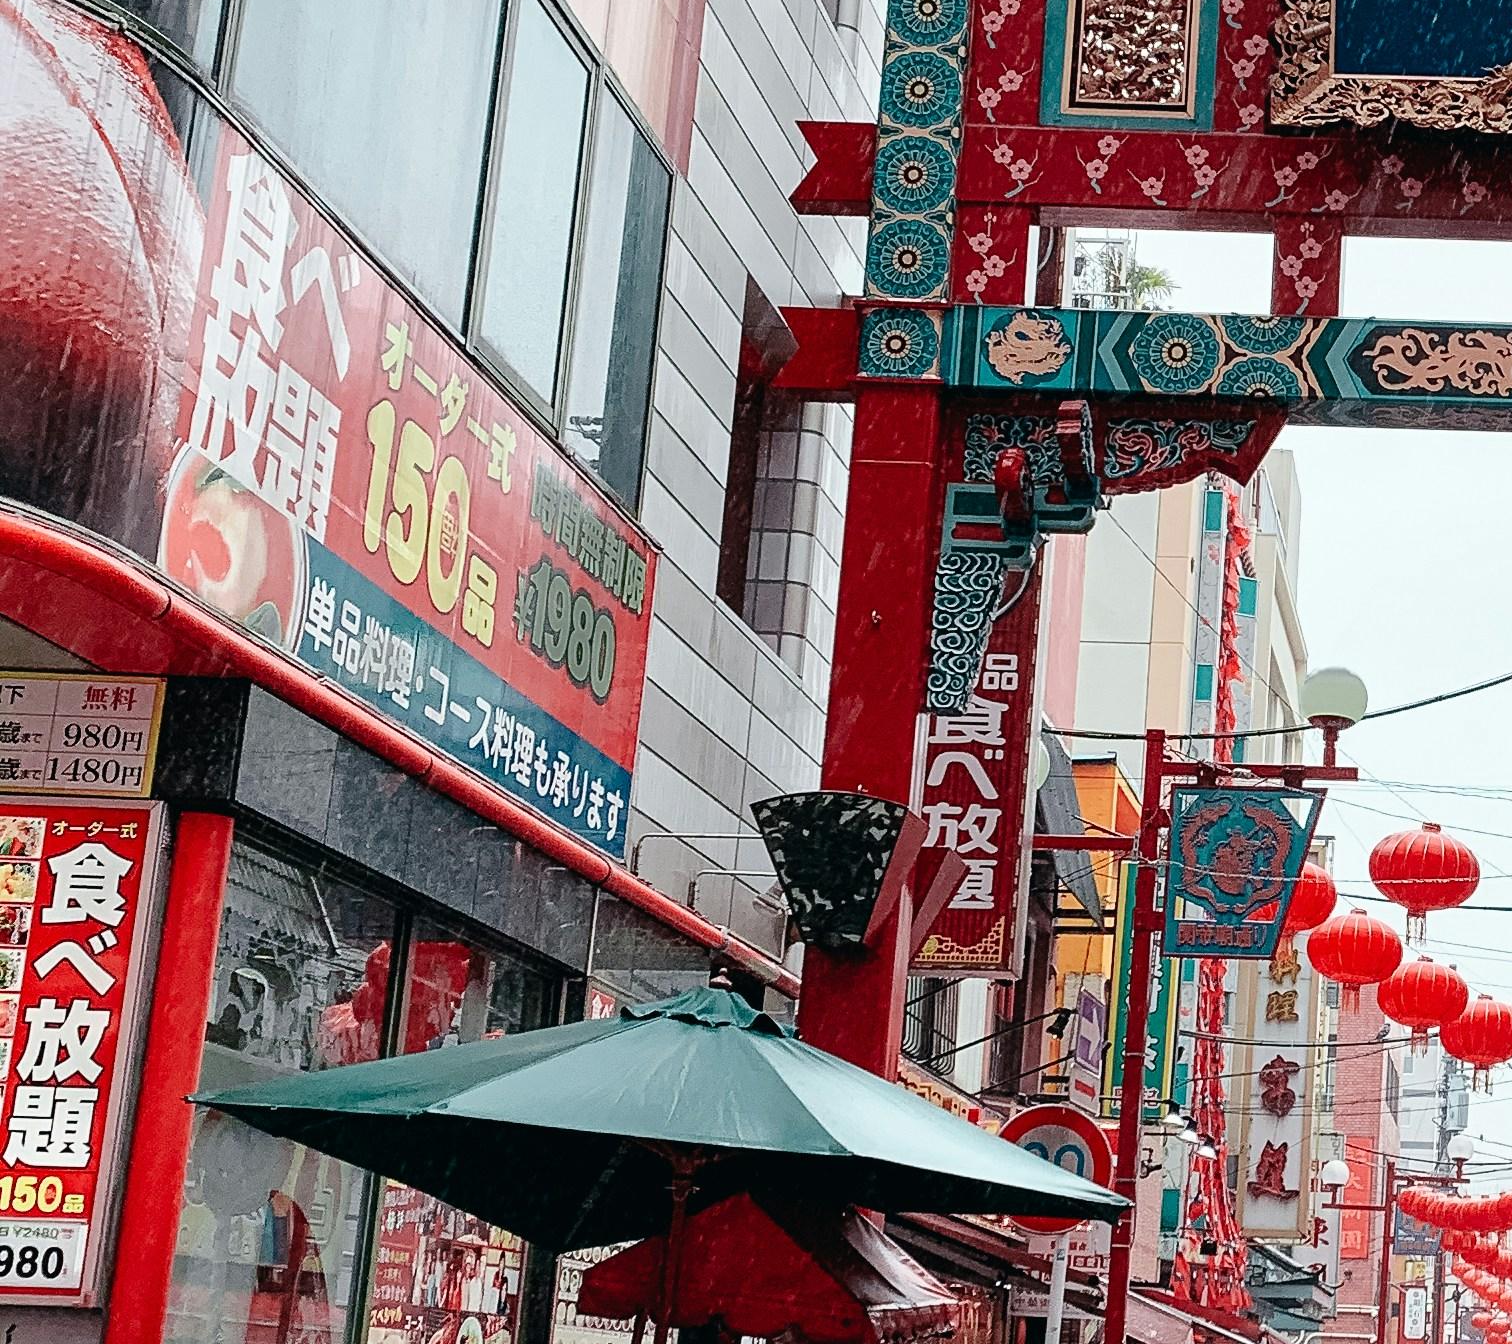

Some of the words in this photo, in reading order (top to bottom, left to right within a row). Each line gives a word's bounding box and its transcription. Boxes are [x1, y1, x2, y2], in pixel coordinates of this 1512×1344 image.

[381, 320, 517, 494] オーダー式
[531, 459, 648, 616] 時間無制限
[513, 561, 617, 704] ¥1980
[0, 684, 25, 705] 下
[82, 685, 138, 712] 無料
[63, 723, 144, 752] 980円
[47, 757, 143, 787] 1480円
[52, 820, 138, 840] オーダー式
[3, 842, 135, 1168] 食べ放題
